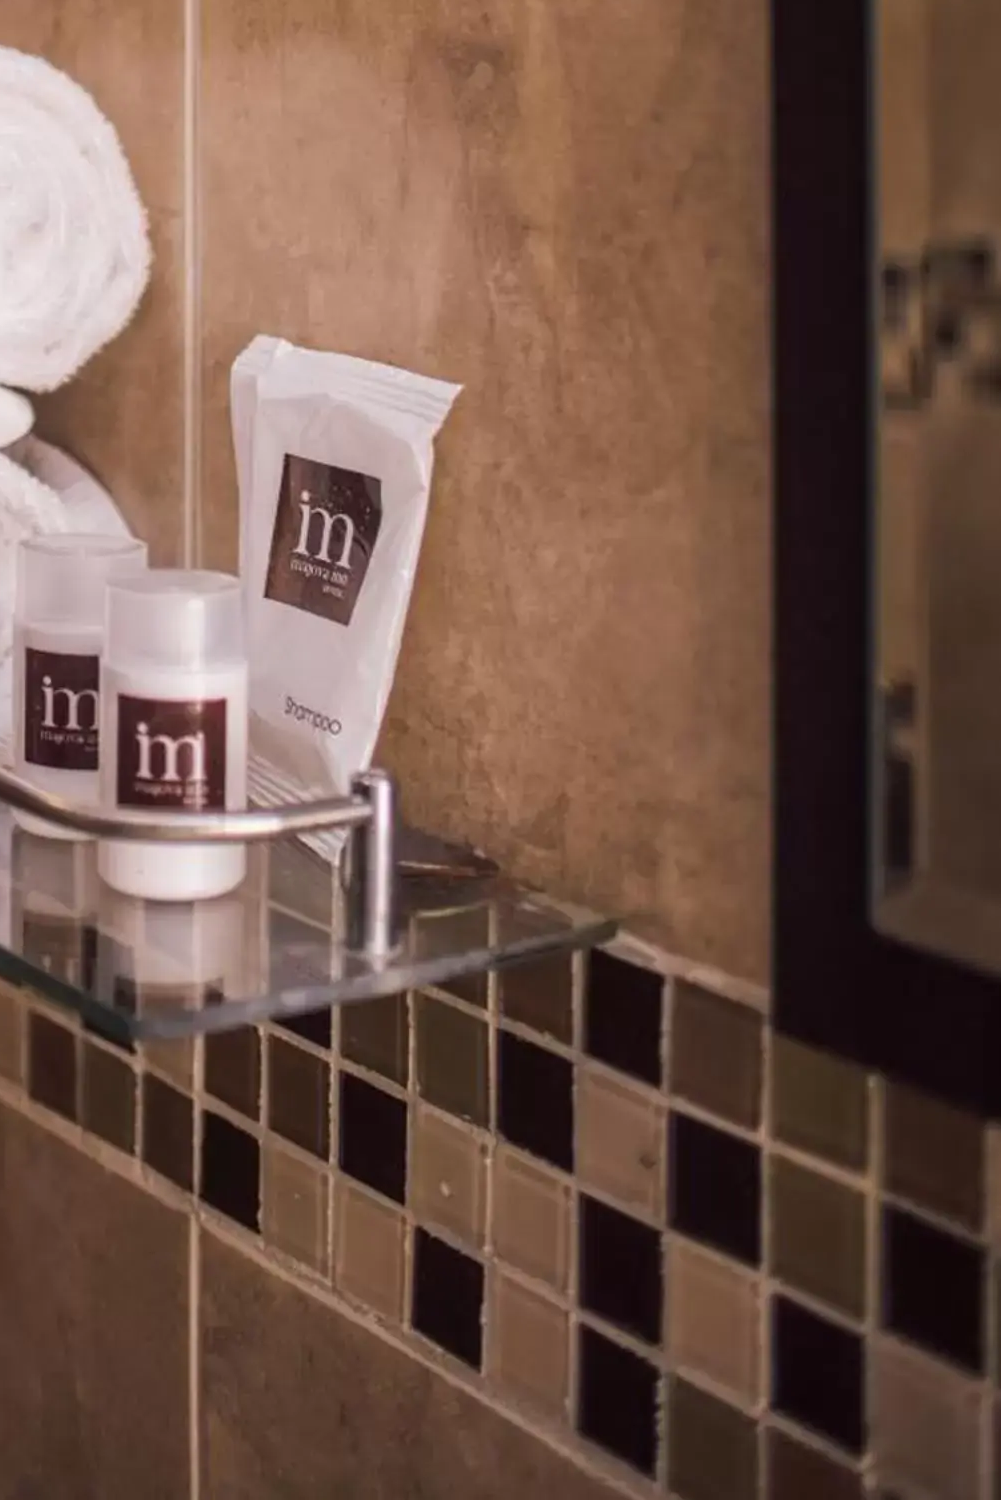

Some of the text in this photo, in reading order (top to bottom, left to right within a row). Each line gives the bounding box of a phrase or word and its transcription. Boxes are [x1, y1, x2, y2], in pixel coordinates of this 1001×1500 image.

[292, 489, 352, 569] im
[41, 675, 99, 730] im
[135, 722, 207, 781] im
